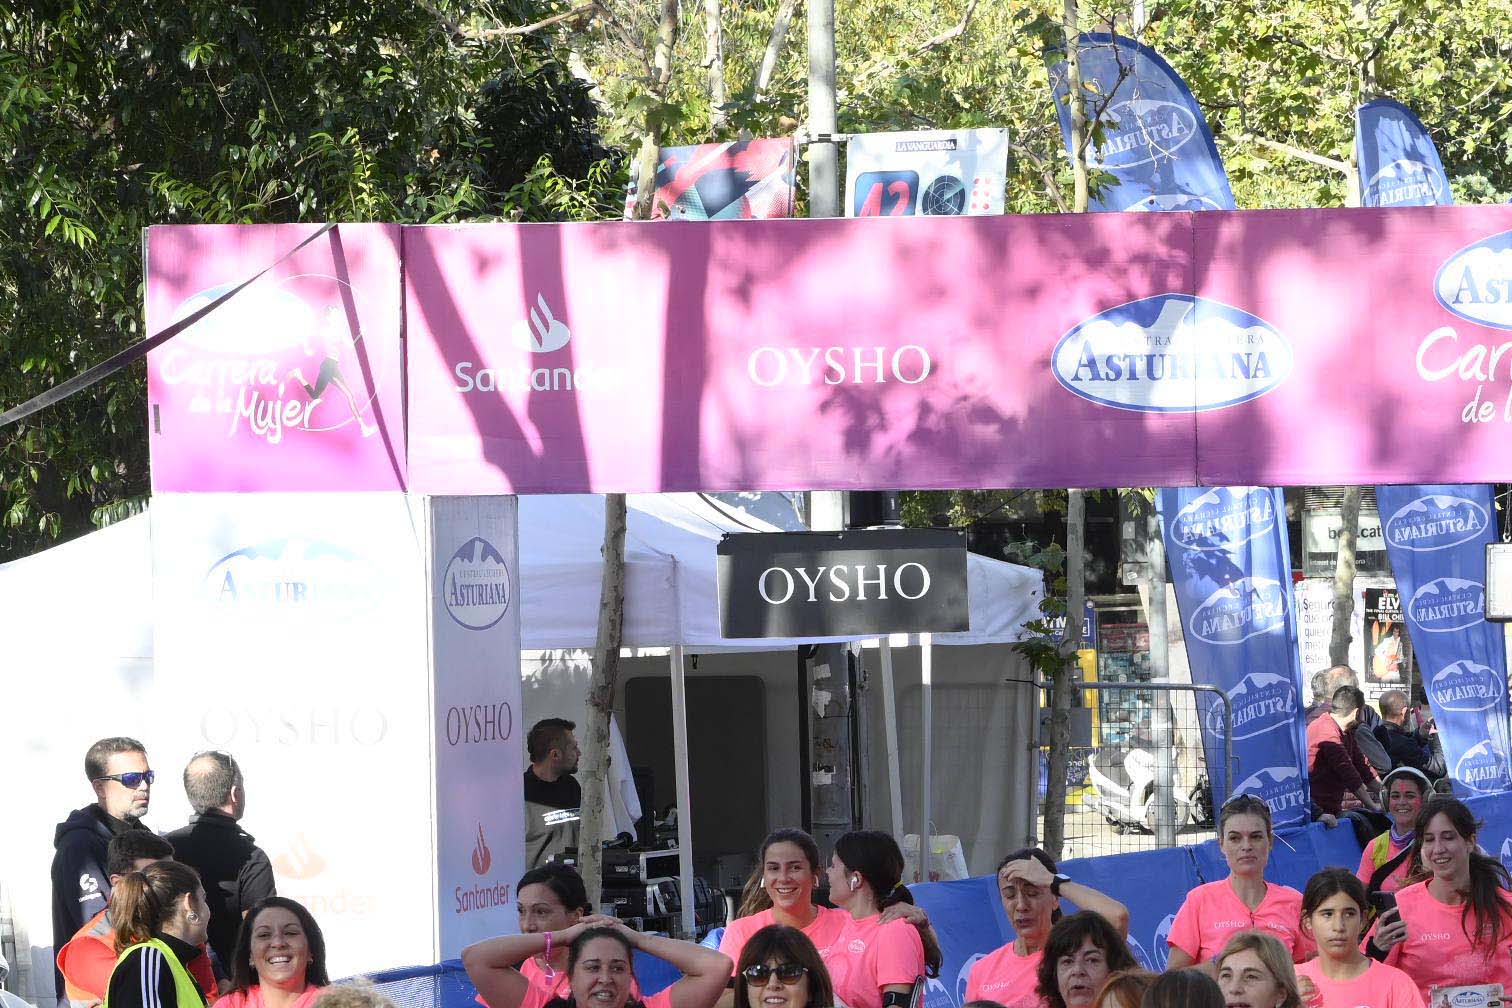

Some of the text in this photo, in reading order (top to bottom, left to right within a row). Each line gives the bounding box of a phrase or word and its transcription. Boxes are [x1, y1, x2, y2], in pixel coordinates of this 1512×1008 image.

[748, 345, 932, 388] OYSHO
[228, 384, 323, 445] Mujer
[1461, 384, 1496, 424] de
[448, 576, 508, 608] ASTURIANA
[758, 562, 931, 605] OYSHO
[446, 702, 512, 746] OYSHO
[455, 882, 511, 915] Santander
